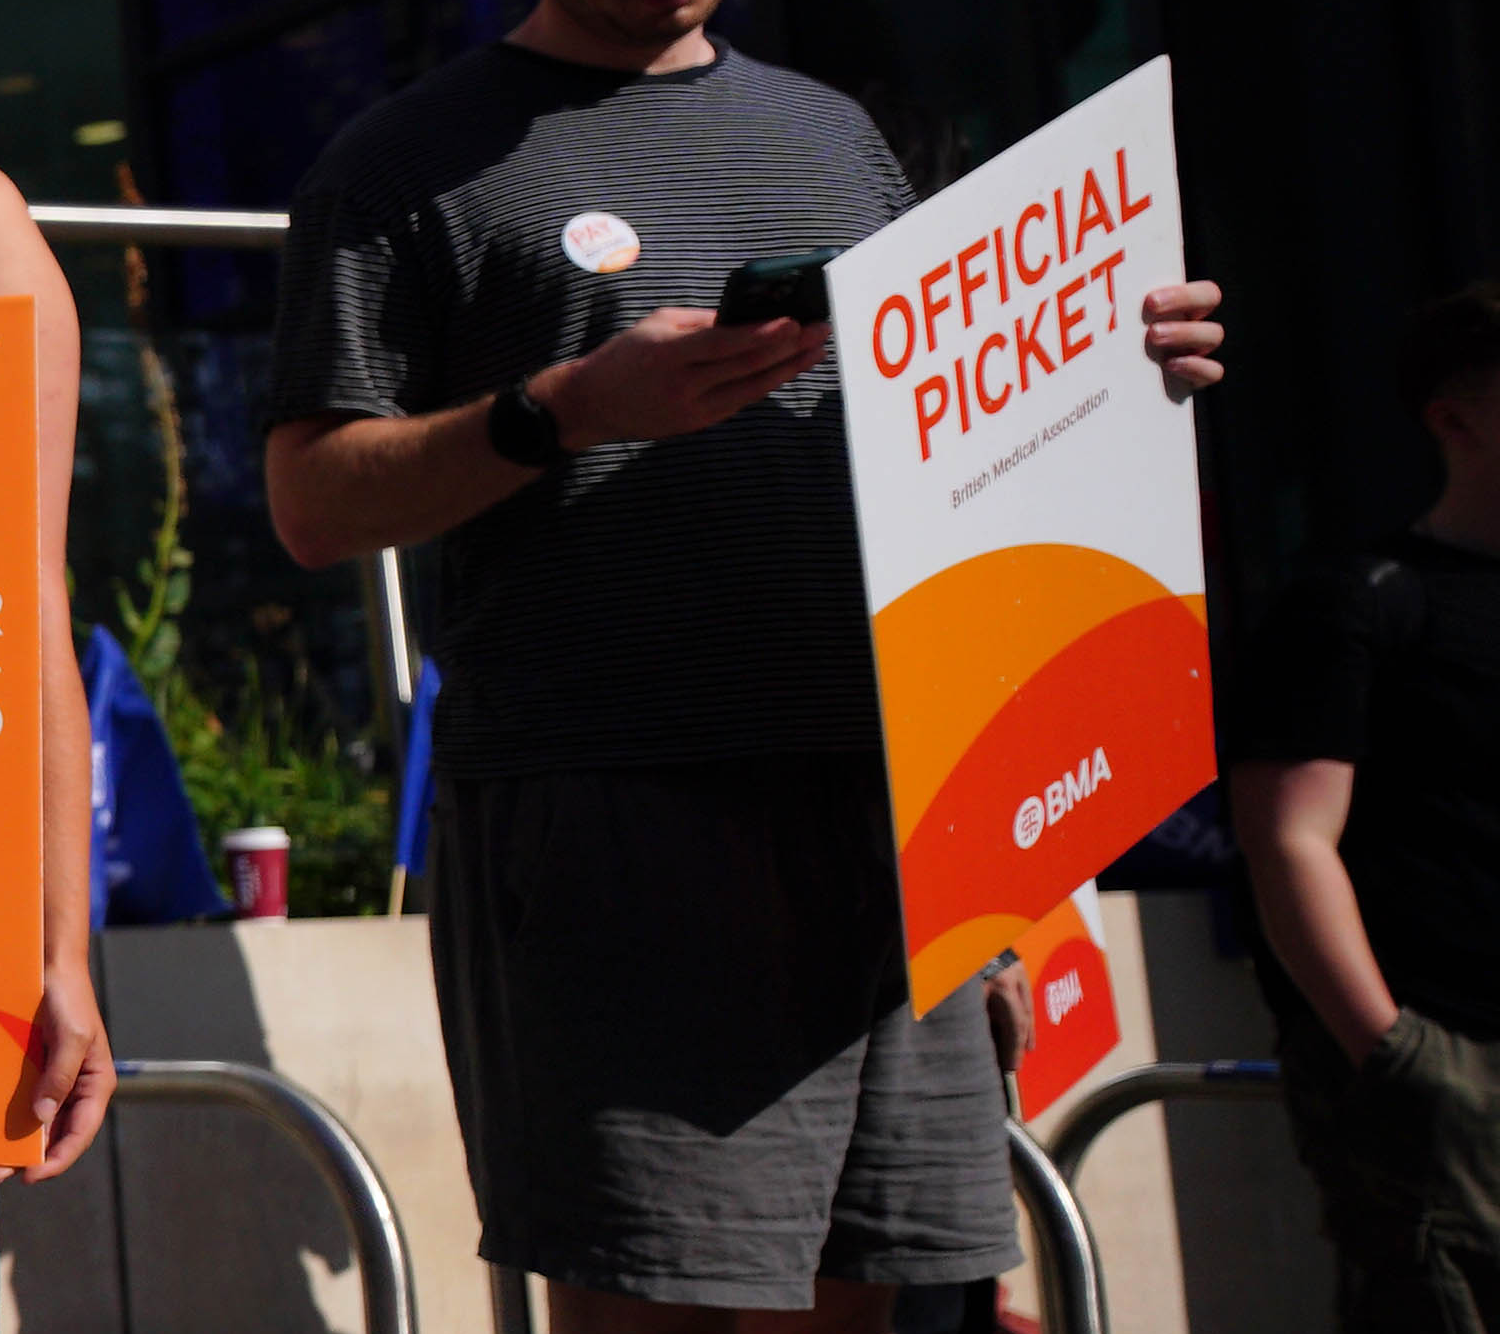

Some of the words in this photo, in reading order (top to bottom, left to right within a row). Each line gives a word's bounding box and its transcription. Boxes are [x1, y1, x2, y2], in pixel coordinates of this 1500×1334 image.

[873, 147, 1152, 379] OFFICIAL
[915, 249, 1126, 462] PICKET
[952, 471, 991, 510] British
[993, 431, 1040, 482] Medical
[1041, 387, 1109, 447] Association
[1043, 747, 1111, 828] BMA
